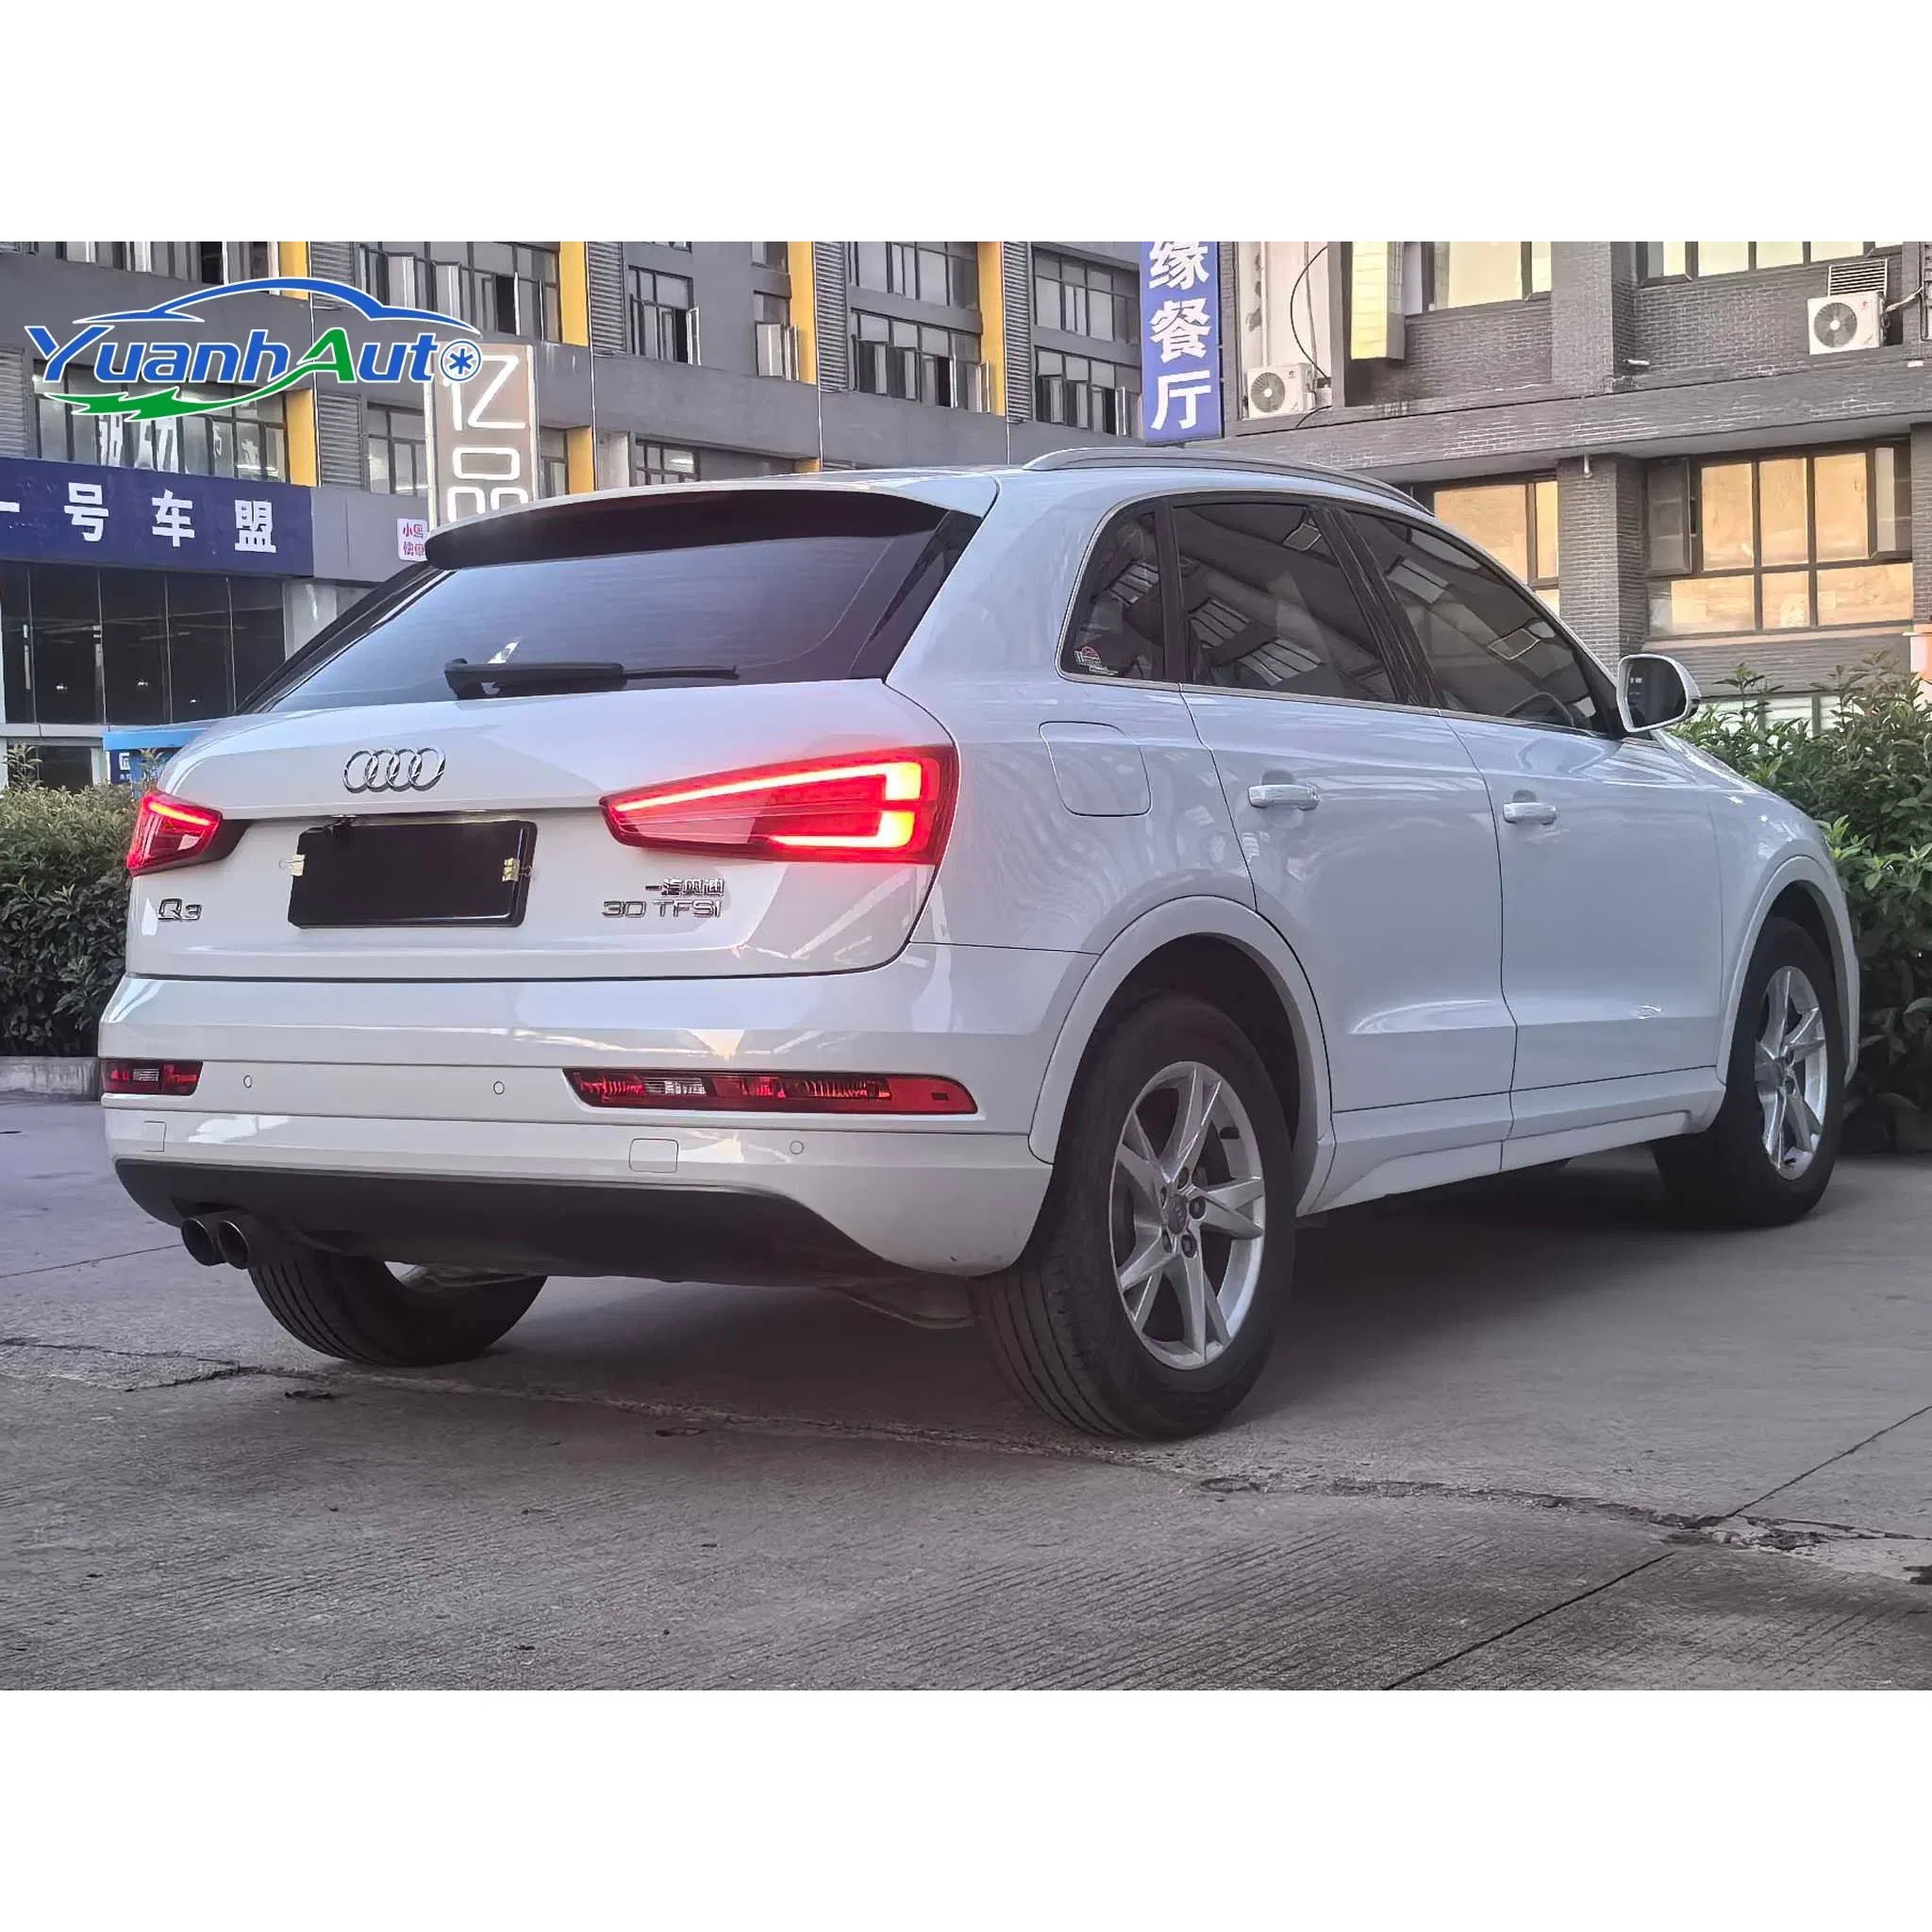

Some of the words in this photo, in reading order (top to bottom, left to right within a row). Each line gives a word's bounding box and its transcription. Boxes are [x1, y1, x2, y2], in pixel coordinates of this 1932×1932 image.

[1148, 242, 1212, 430] 缘餐厅
[158, 898, 203, 922] Q3
[601, 900, 647, 919] 30
[652, 899, 723, 918] TFSI
